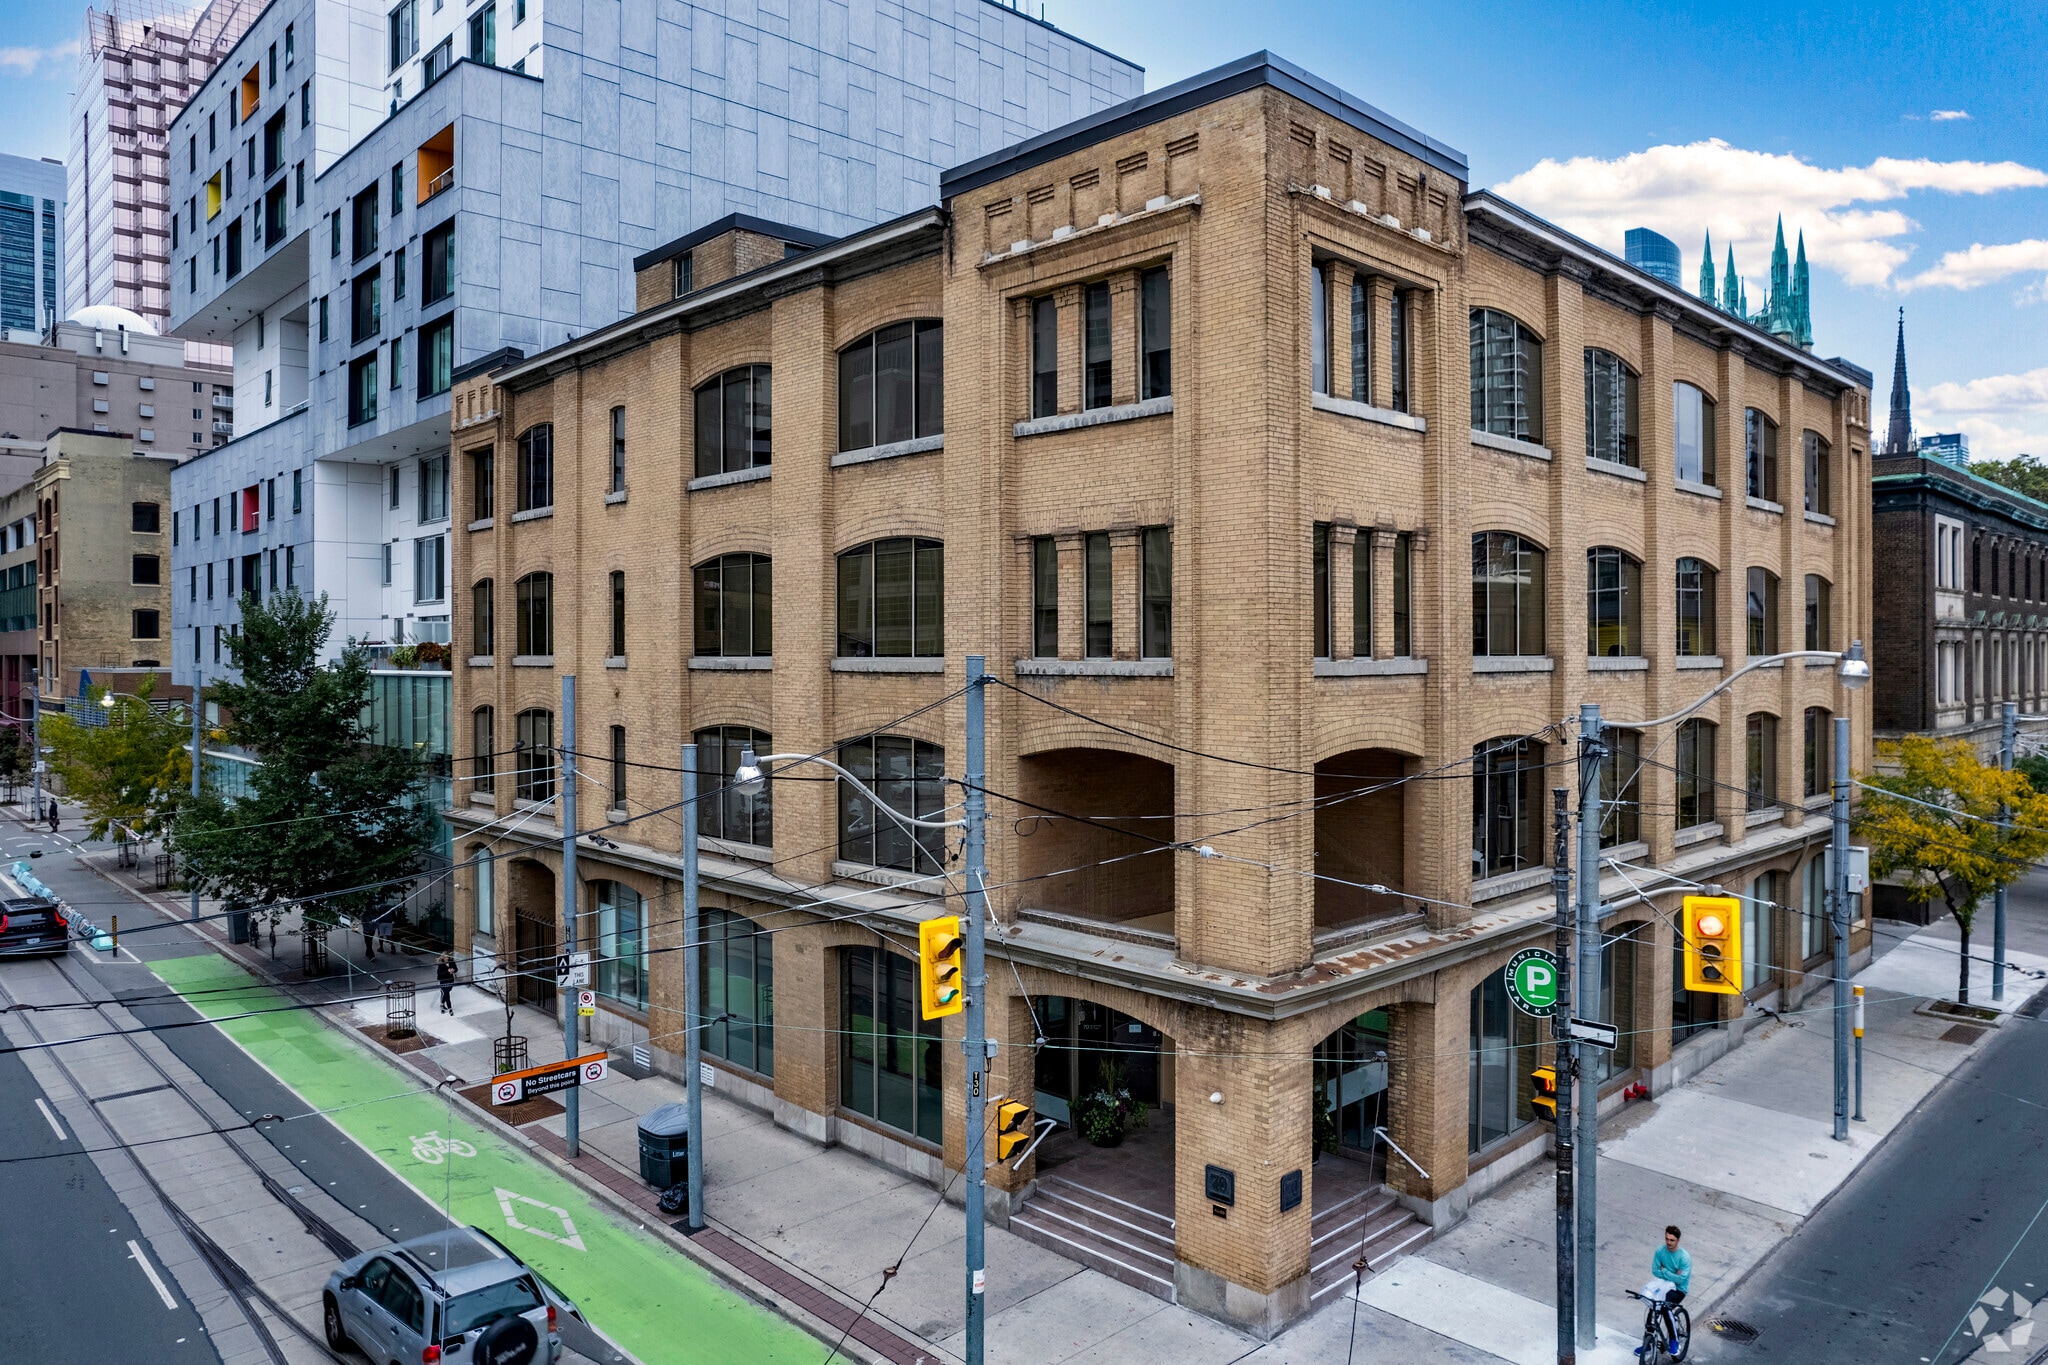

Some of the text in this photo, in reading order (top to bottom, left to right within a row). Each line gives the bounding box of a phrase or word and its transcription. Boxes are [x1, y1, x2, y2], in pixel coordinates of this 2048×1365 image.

[1508, 951, 1557, 977] MUNICIP
[1527, 965, 1552, 992] P
[1508, 985, 1557, 1014] PARKI
[525, 1070, 577, 1087] No Streetcars
[527, 1079, 575, 1095] Beyond this point
